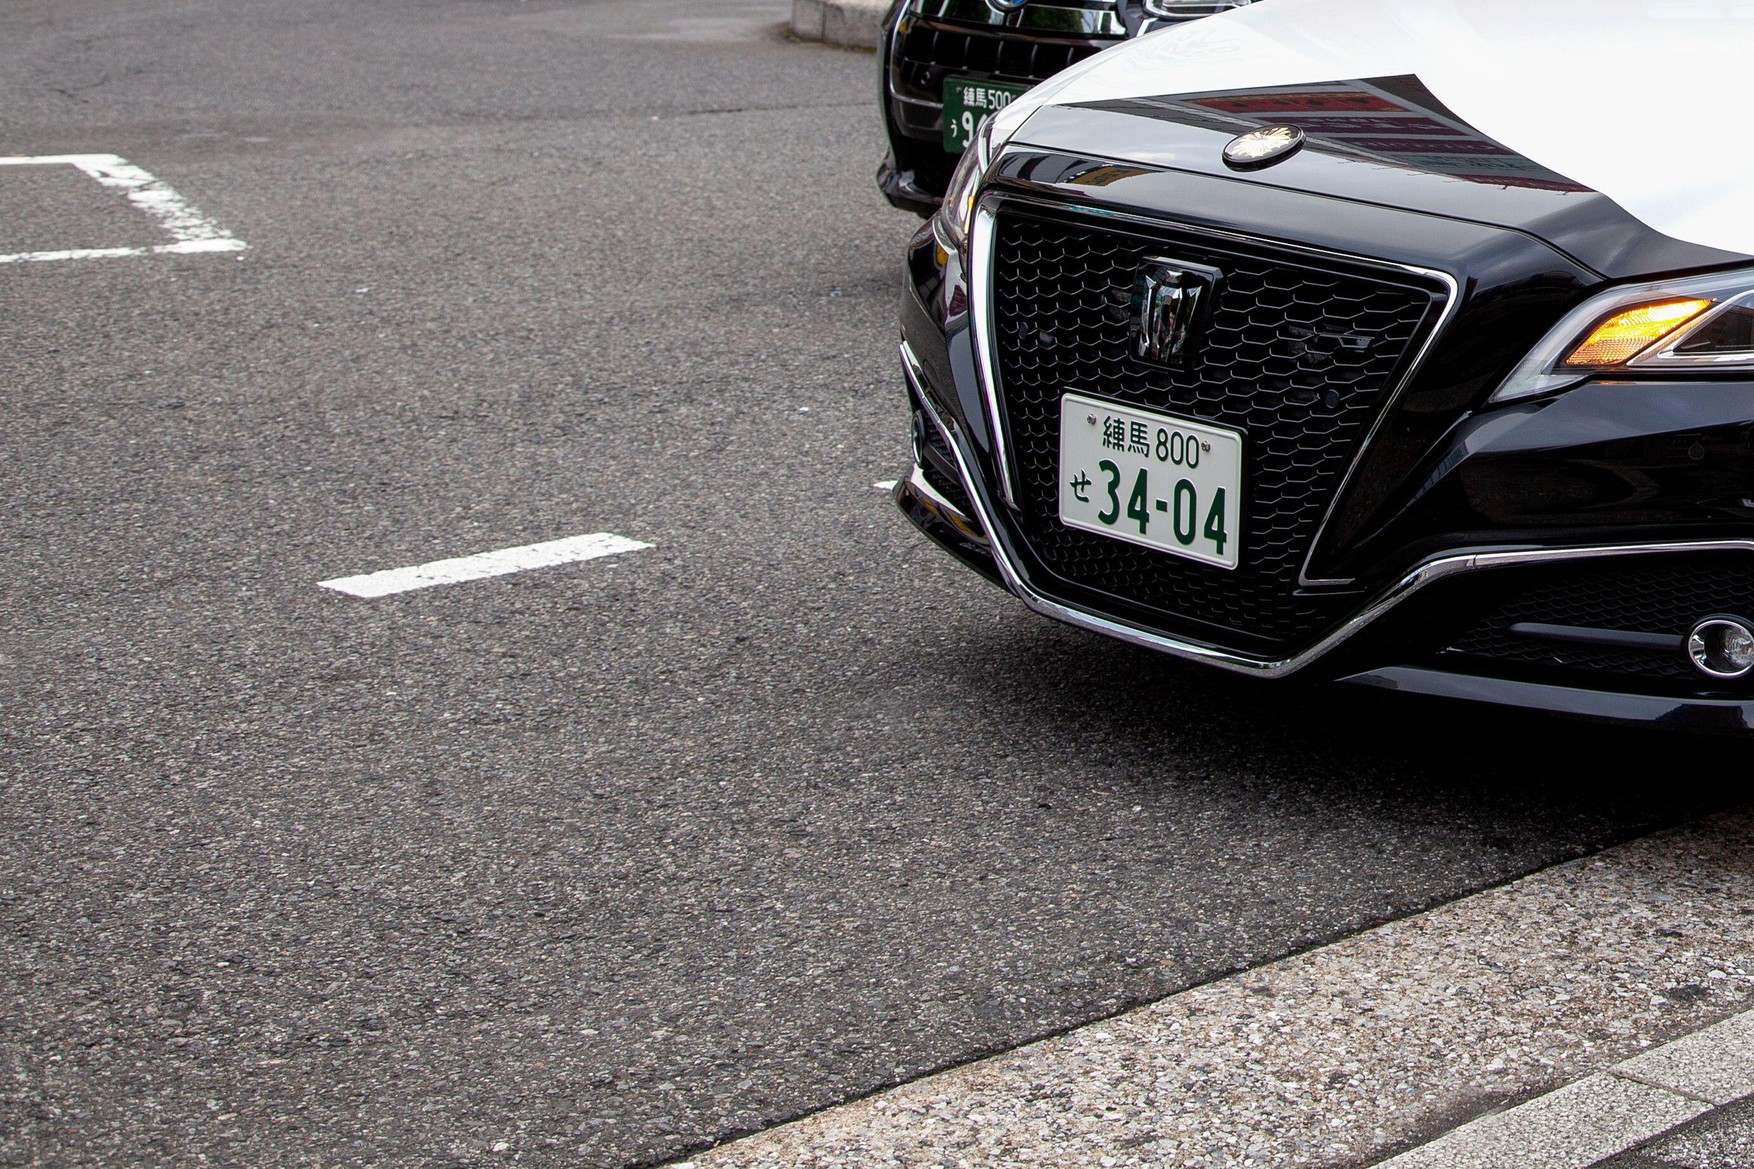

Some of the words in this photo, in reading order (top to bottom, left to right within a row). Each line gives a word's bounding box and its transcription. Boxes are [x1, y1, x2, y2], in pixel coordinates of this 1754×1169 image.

[950, 118, 958, 138] う
[1069, 469, 1092, 503] せ
[1097, 458, 1228, 556] 34-04
